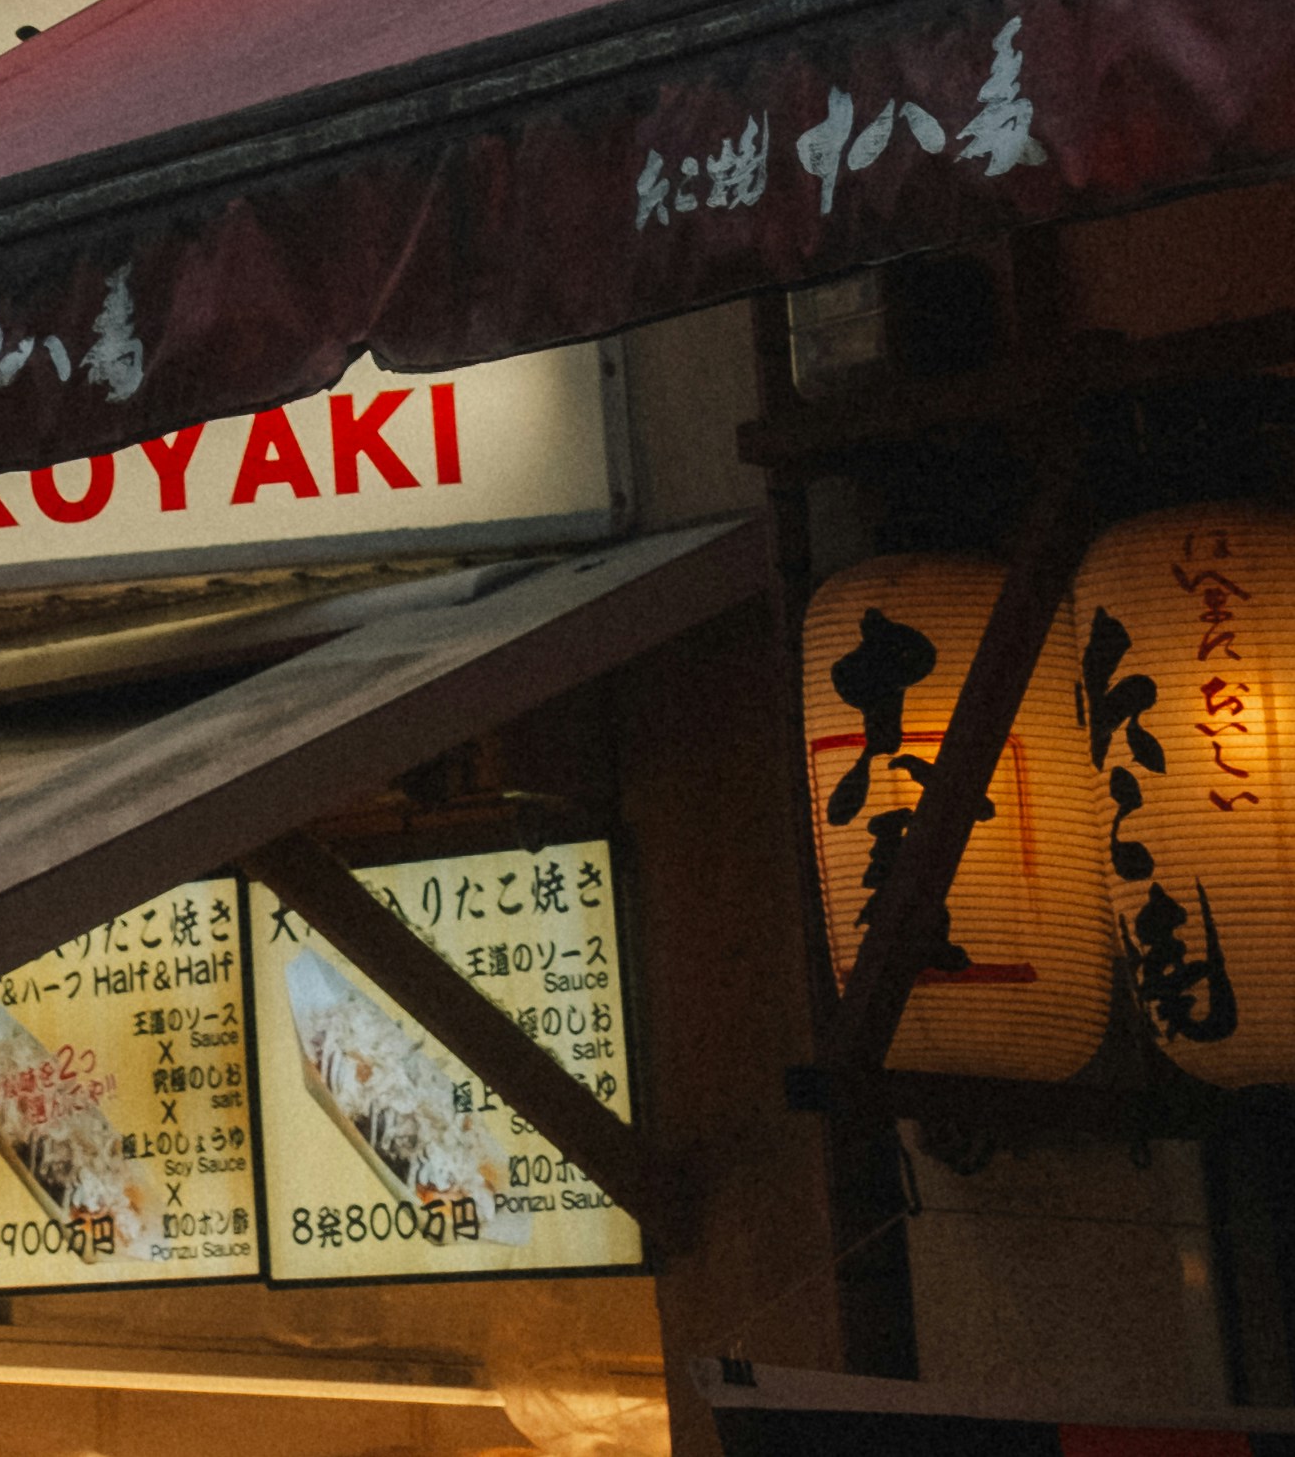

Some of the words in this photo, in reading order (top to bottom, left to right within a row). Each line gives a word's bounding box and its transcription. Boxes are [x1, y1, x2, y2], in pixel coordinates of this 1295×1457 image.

[467, 936, 607, 978] 王道のソース
[544, 971, 609, 993] Sauce
[189, 1030, 240, 1049] Sauce
[572, 1040, 614, 1060] salt
[211, 1091, 243, 1109] salt
[197, 1155, 247, 1174] Sauce
[495, 1193, 555, 1214] Ponzu
[561, 1190, 615, 1211] Sauc
[292, 1195, 480, 1248] 8発800万円
[151, 1241, 198, 1263] Ponzu
[202, 1240, 251, 1259] Sauce
